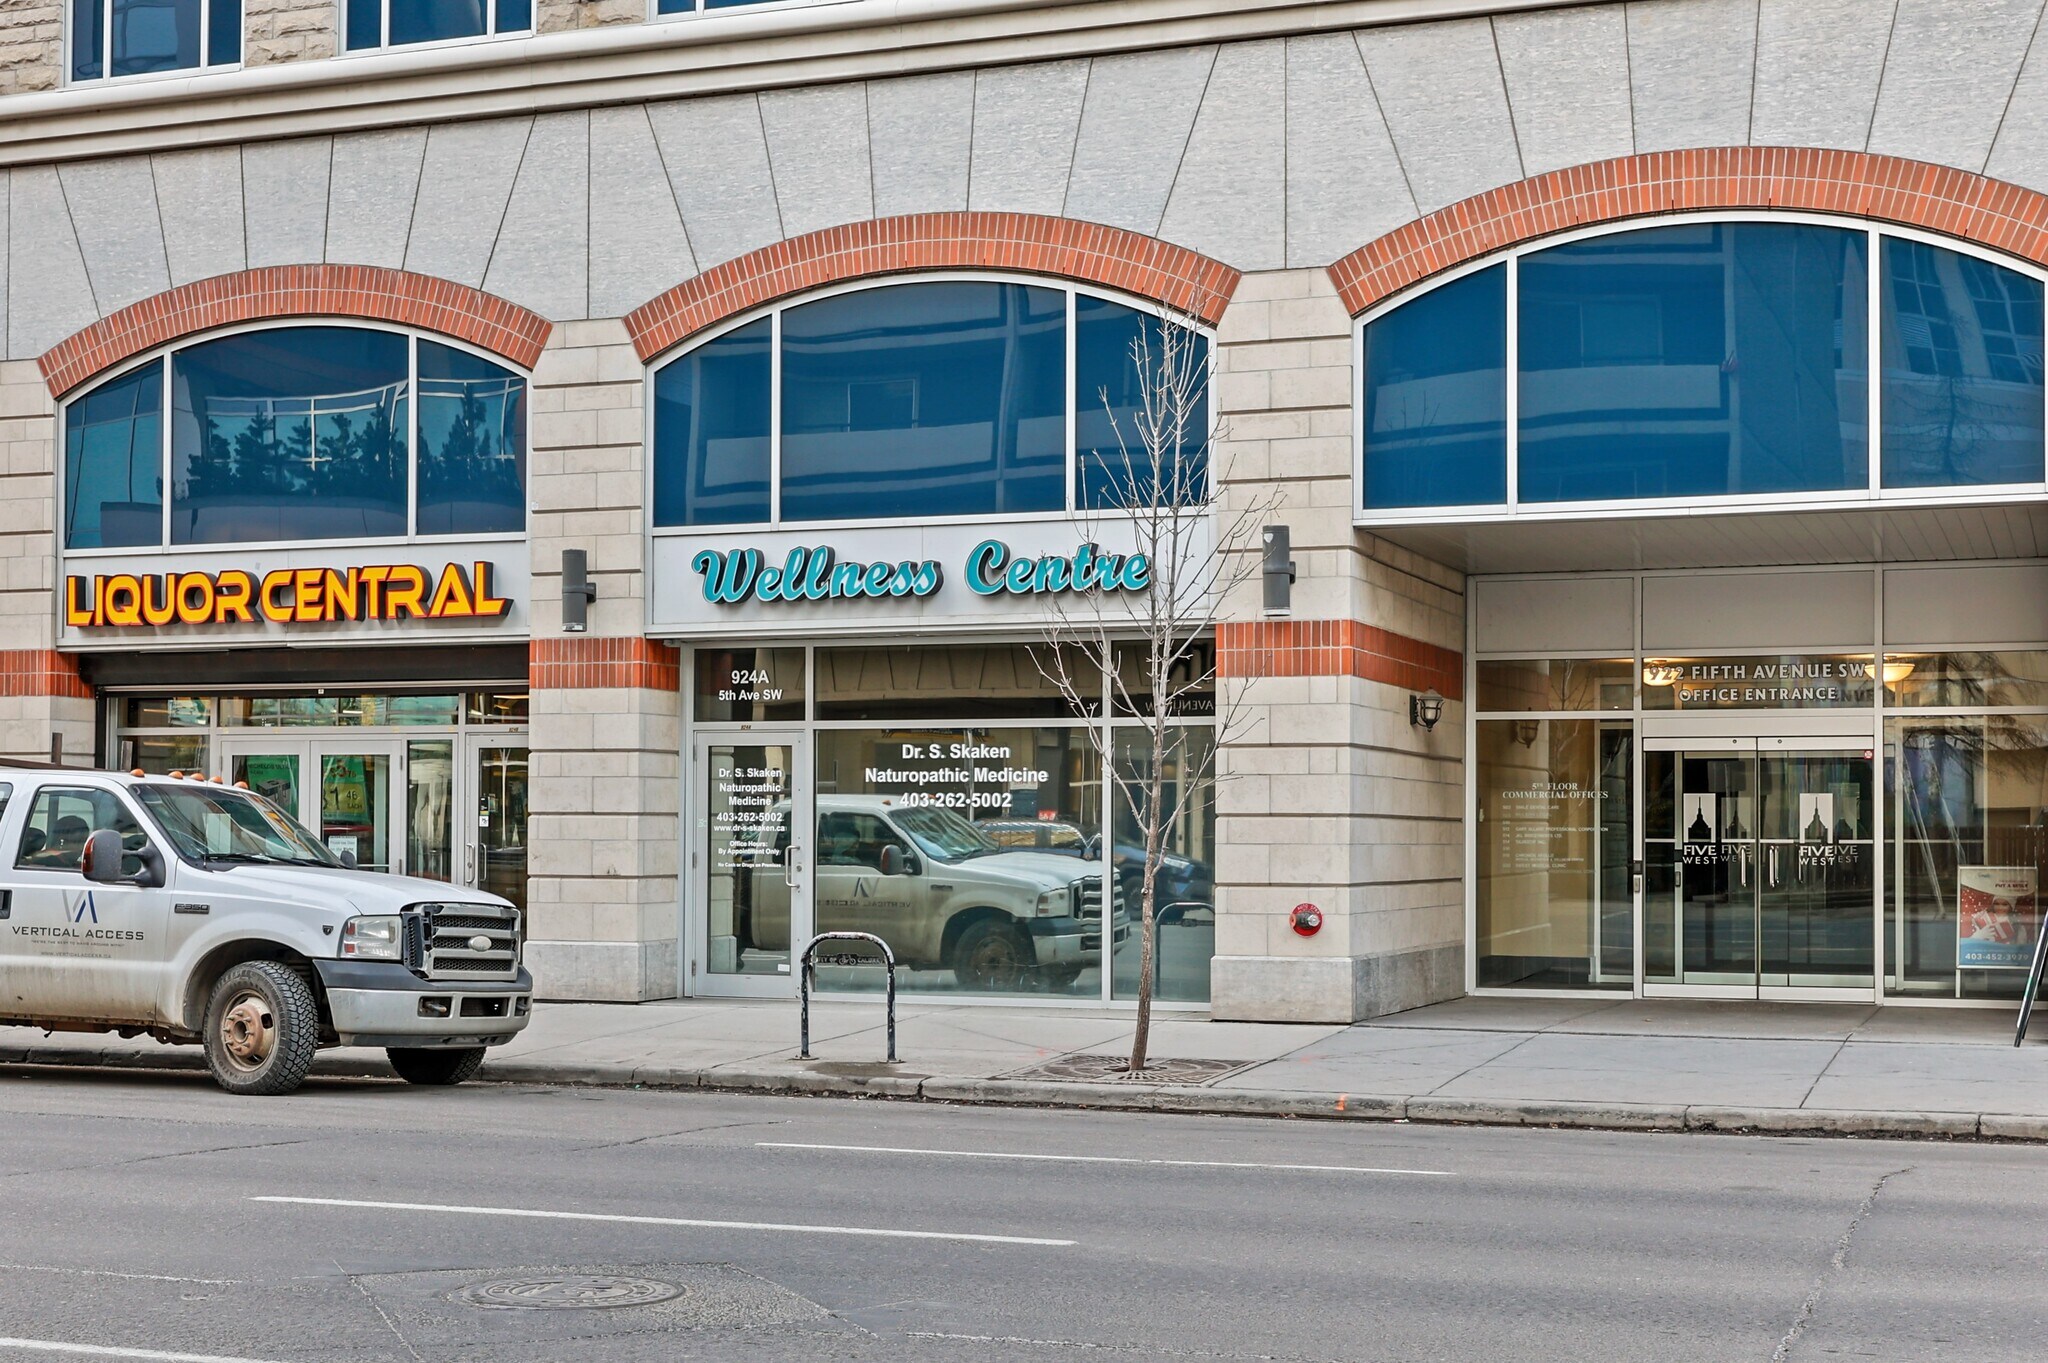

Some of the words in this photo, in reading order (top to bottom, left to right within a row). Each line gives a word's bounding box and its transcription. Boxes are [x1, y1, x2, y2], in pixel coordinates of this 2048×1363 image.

[691, 545, 944, 604] Wellness
[964, 539, 1152, 597] Centre
[66, 570, 263, 627] LIQUOR
[260, 561, 514, 623] CENTRAL
[731, 669, 770, 684] 924A
[1649, 665, 1685, 681] 922
[1691, 665, 1746, 680] FIFTH
[1753, 663, 1833, 679] AVENUE
[1838, 663, 1866, 678] SW
[718, 689, 736, 700] 5th
[738, 689, 760, 700] Ave
[763, 689, 783, 700] SW
[1678, 688, 1739, 701] OFFICE
[1745, 687, 1837, 701] ENTRANCE
[902, 744, 925, 759] Dr.
[929, 743, 946, 759] S.
[950, 743, 1010, 759] Skaken
[718, 768, 732, 778] Dr.
[734, 768, 744, 778] S.
[746, 768, 782, 778] Skaken
[865, 768, 970, 786] Naturopathic
[974, 767, 1049, 783] Medicine
[719, 783, 781, 794] Naturopathic
[1502, 791, 1567, 799] COMMERCIAL
[1569, 791, 1609, 799] OFFICES
[728, 796, 772, 806] Medicine
[765, 848, 780, 856] Only
[1683, 845, 1717, 856] FIVE
[1800, 845, 1834, 856] FIVE
[1682, 856, 1718, 865] WEST
[1720, 855, 1752, 863] WET
[1800, 857, 1835, 866] WEST
[12, 926, 80, 938] VERTICAL
[85, 929, 145, 941] ACCESS
